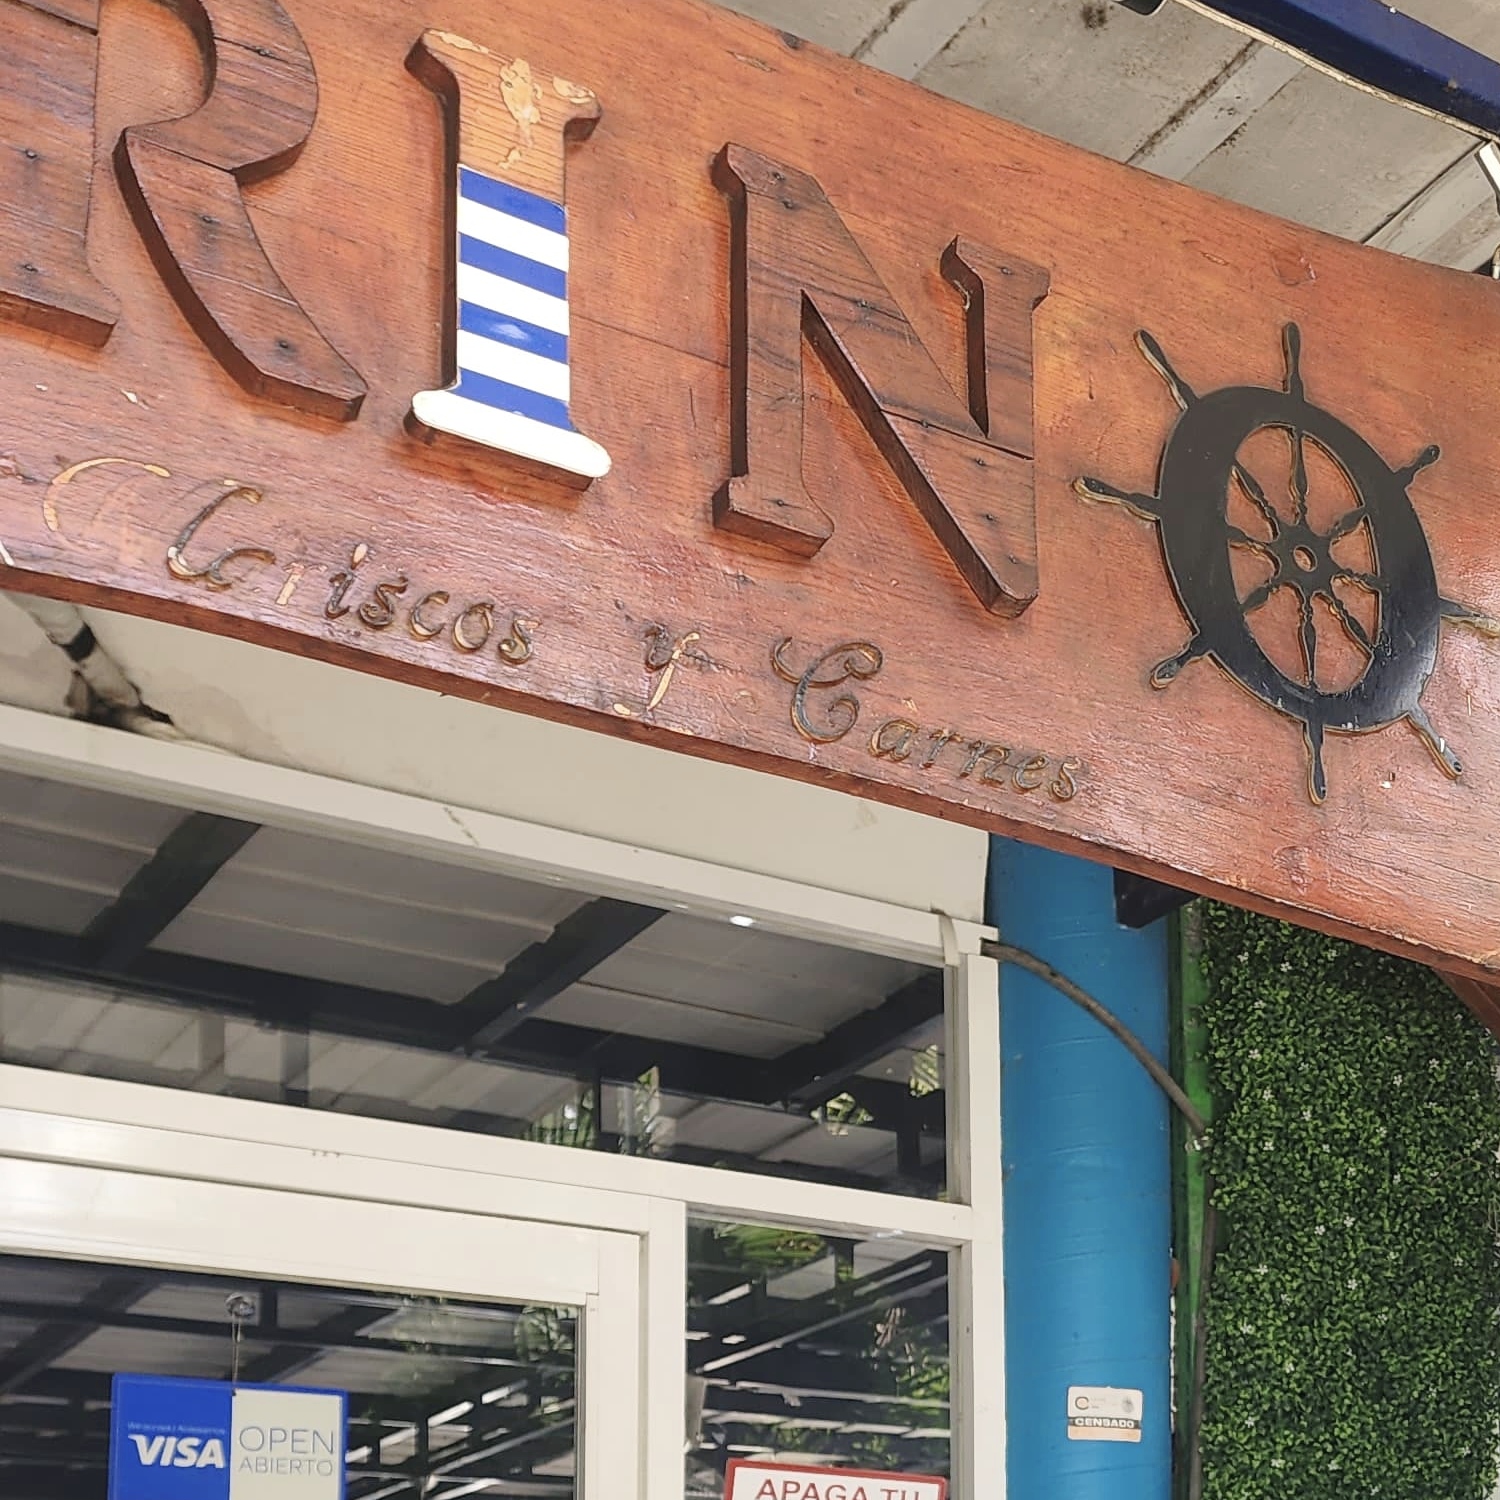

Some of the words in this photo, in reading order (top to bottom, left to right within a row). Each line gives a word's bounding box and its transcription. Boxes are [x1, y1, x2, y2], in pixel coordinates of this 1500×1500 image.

[769, 634, 1086, 803] Carnes
[1074, 1417, 1135, 1429] CENSADO
[128, 1434, 226, 1469] VISA
[239, 1426, 334, 1455] OPEN
[239, 1456, 333, 1477] ABIERTO
